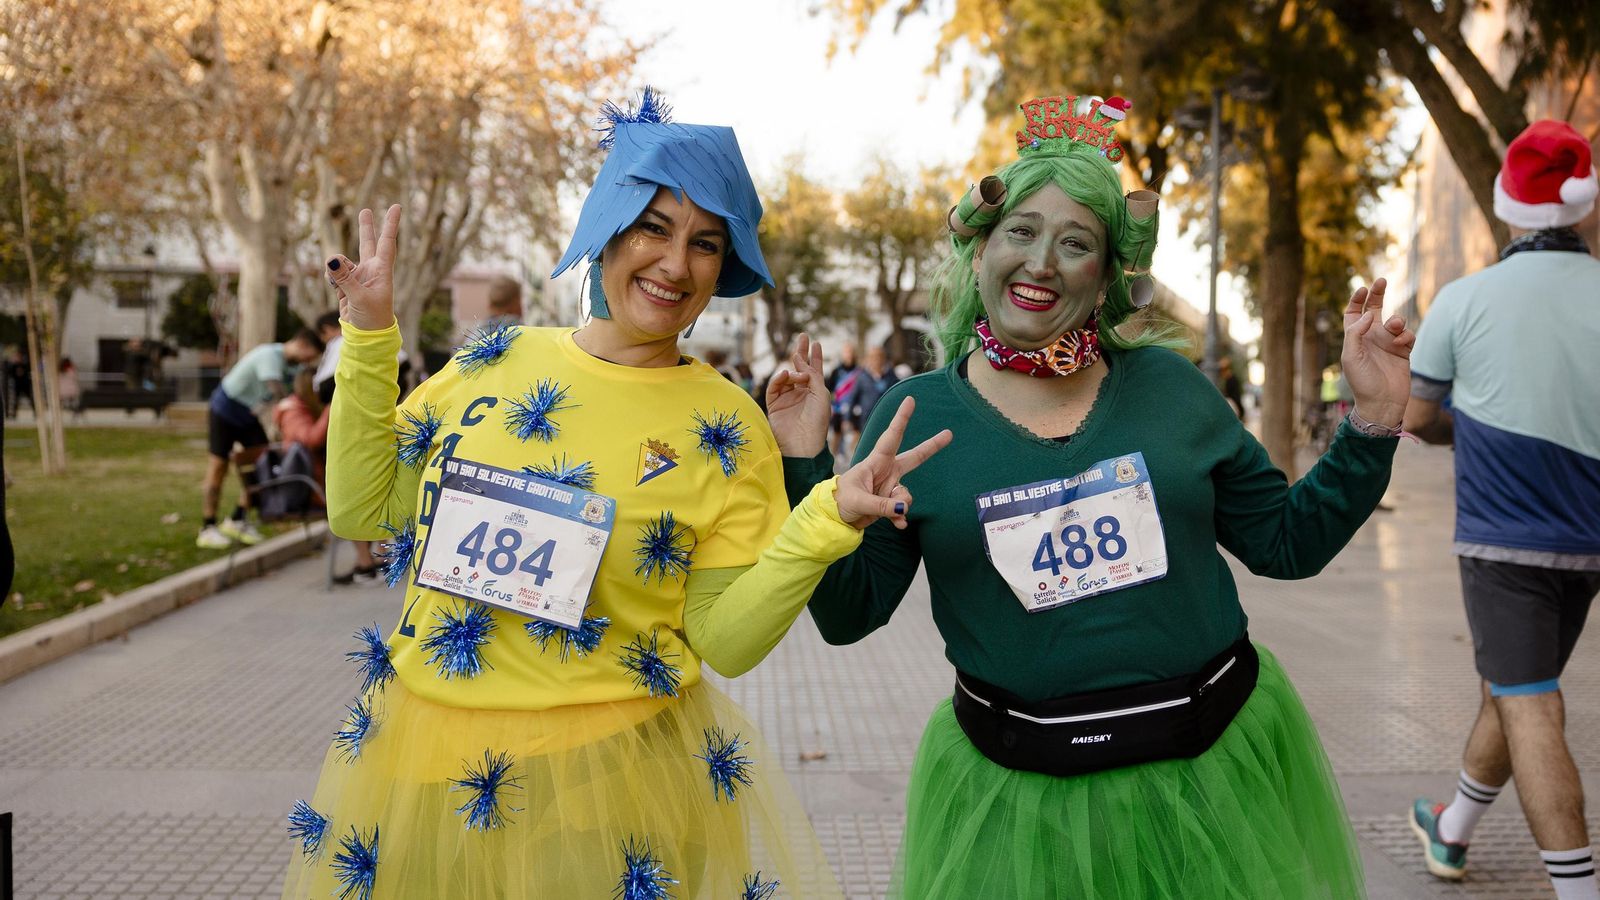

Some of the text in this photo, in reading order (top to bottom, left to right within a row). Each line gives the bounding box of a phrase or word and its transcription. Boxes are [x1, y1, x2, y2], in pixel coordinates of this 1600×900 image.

[446, 461, 574, 505] VII SAN SILVESTRE GADITANA
[978, 496, 991, 509] VII
[993, 492, 1012, 506] SAN
[1014, 480, 1062, 502] SILVESTRE
[456, 520, 557, 587] 484
[1031, 515, 1128, 577] 488
[442, 580, 461, 592] Galicia
[445, 574, 464, 585] Estrella
[1033, 589, 1057, 601] Estrella
[1035, 595, 1058, 605] Galicia
